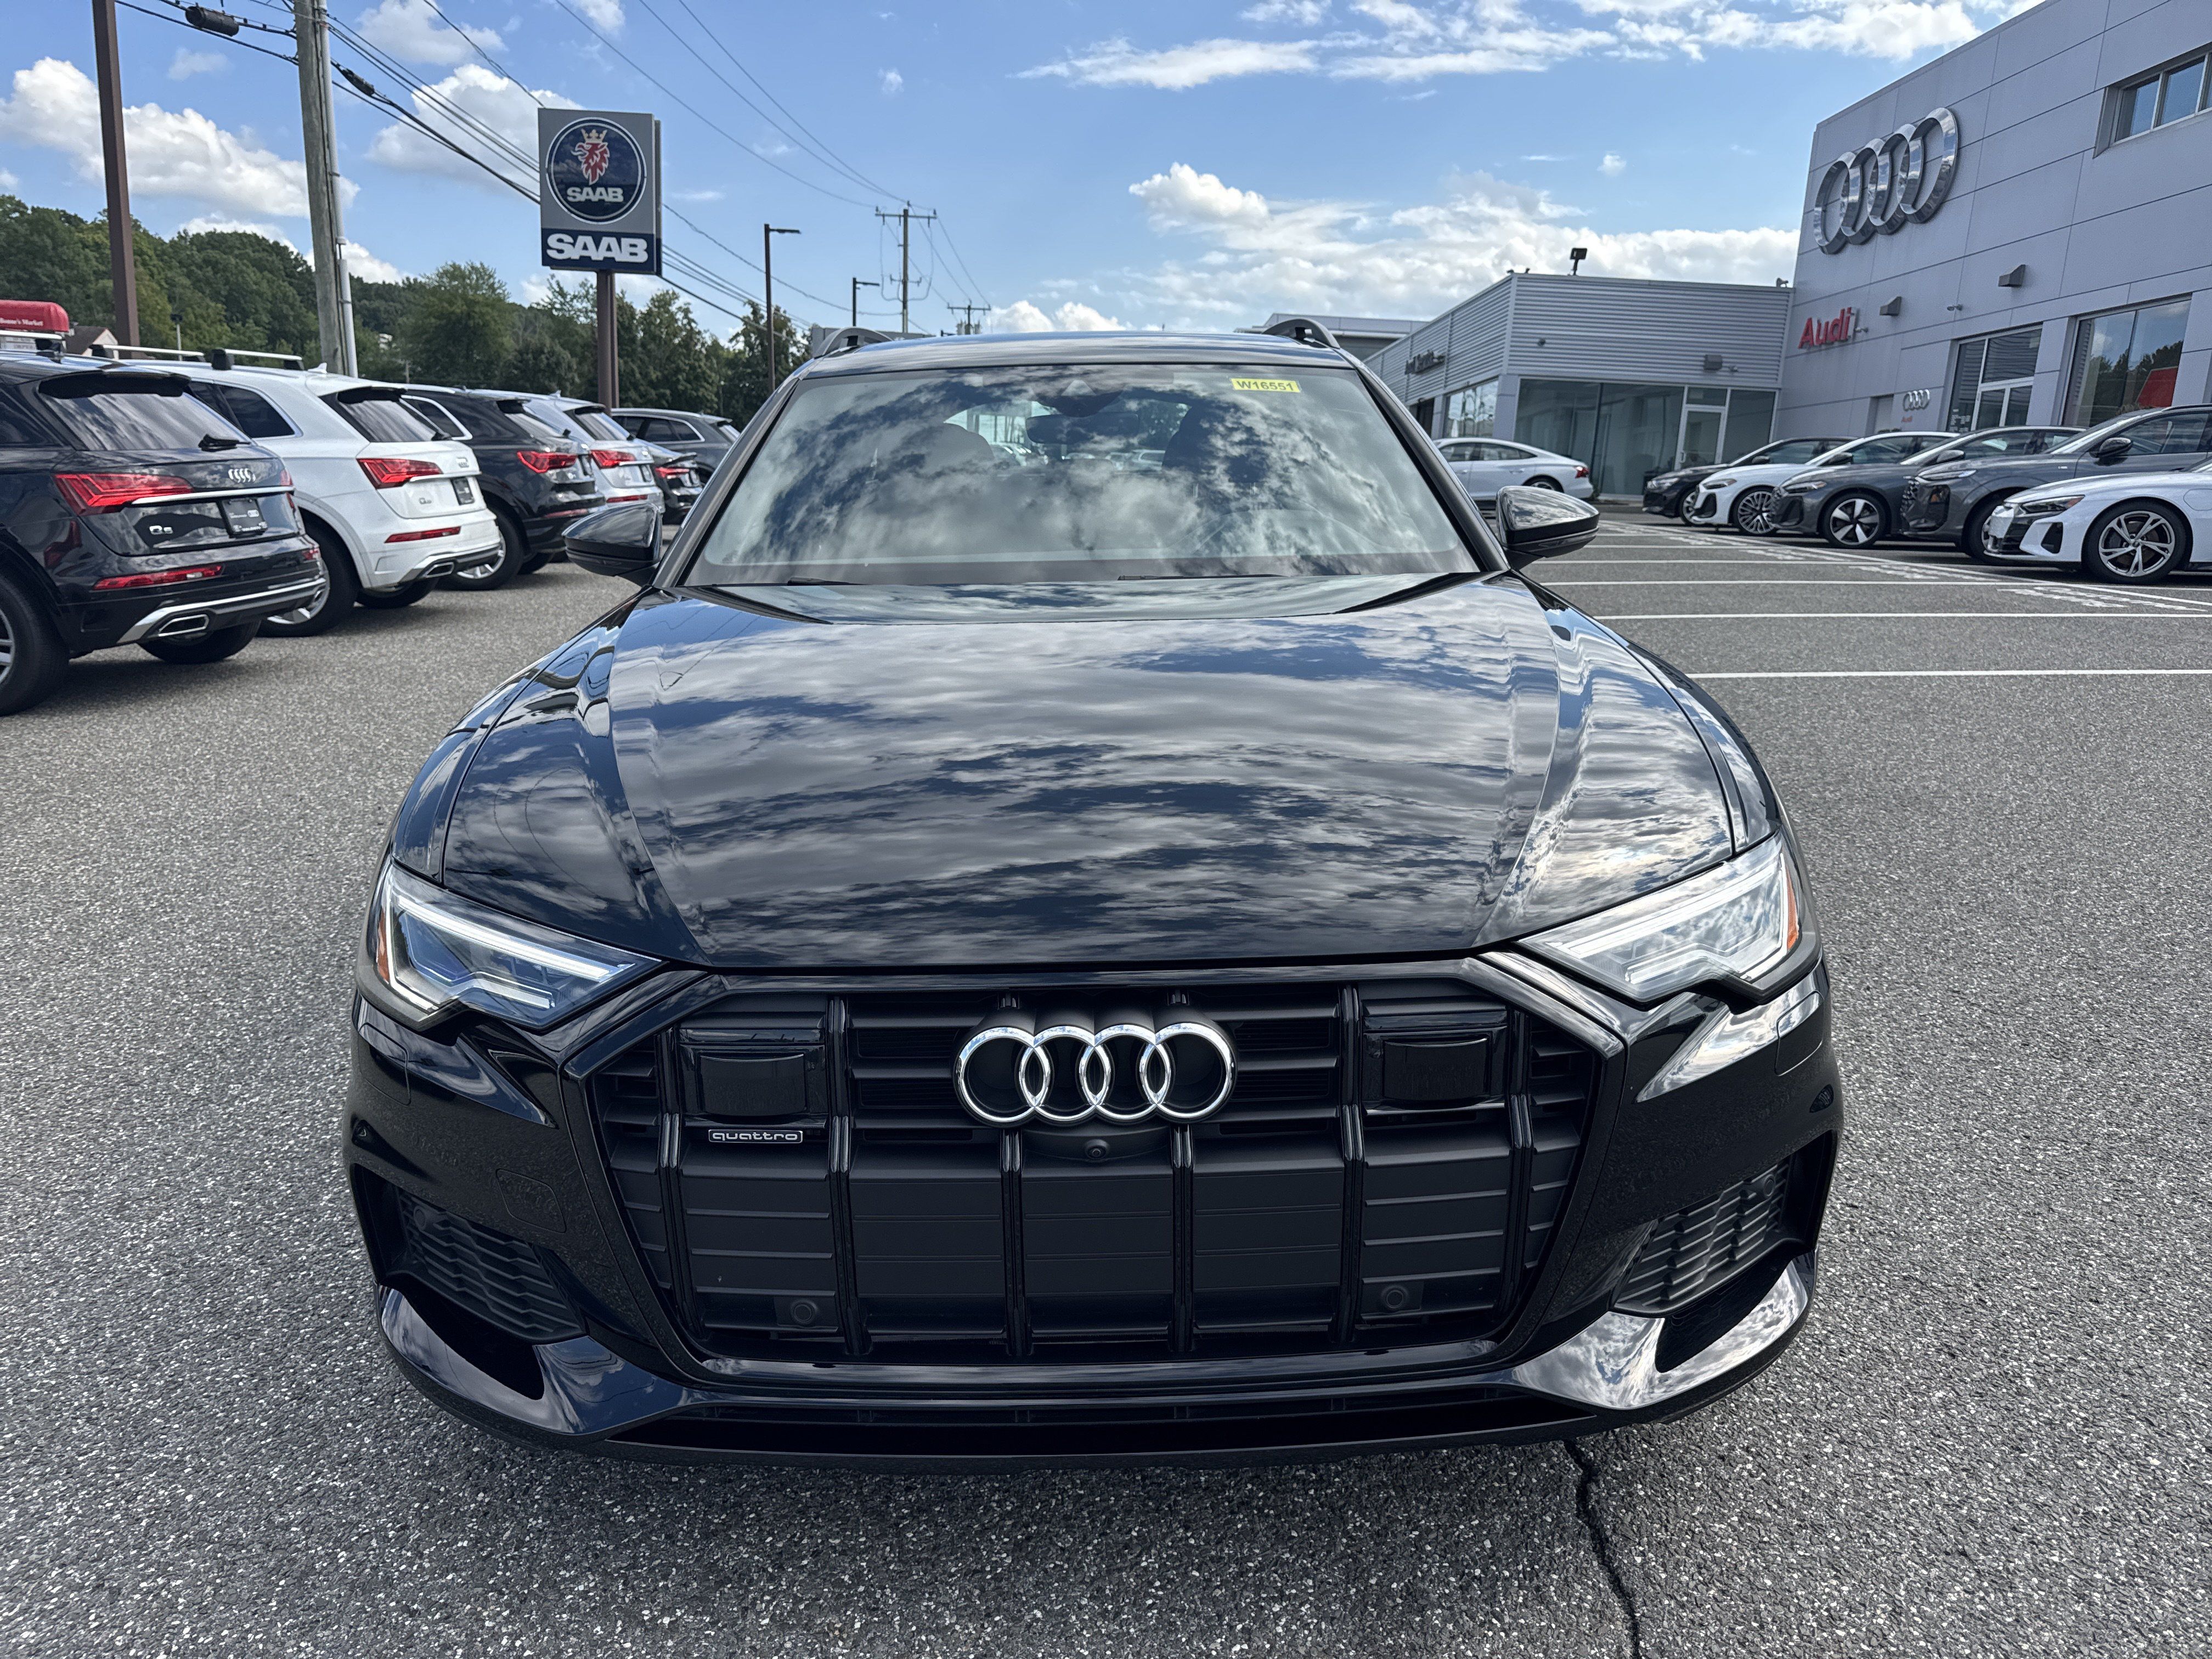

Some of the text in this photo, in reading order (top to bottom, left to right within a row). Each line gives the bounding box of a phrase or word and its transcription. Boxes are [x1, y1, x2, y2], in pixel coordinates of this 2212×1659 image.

[566, 187, 624, 202] SAAB
[546, 233, 648, 263] SAAB
[1798, 307, 1852, 349] Audi
[1237, 381, 1294, 391] W16551
[713, 1132, 798, 1141] quattro
